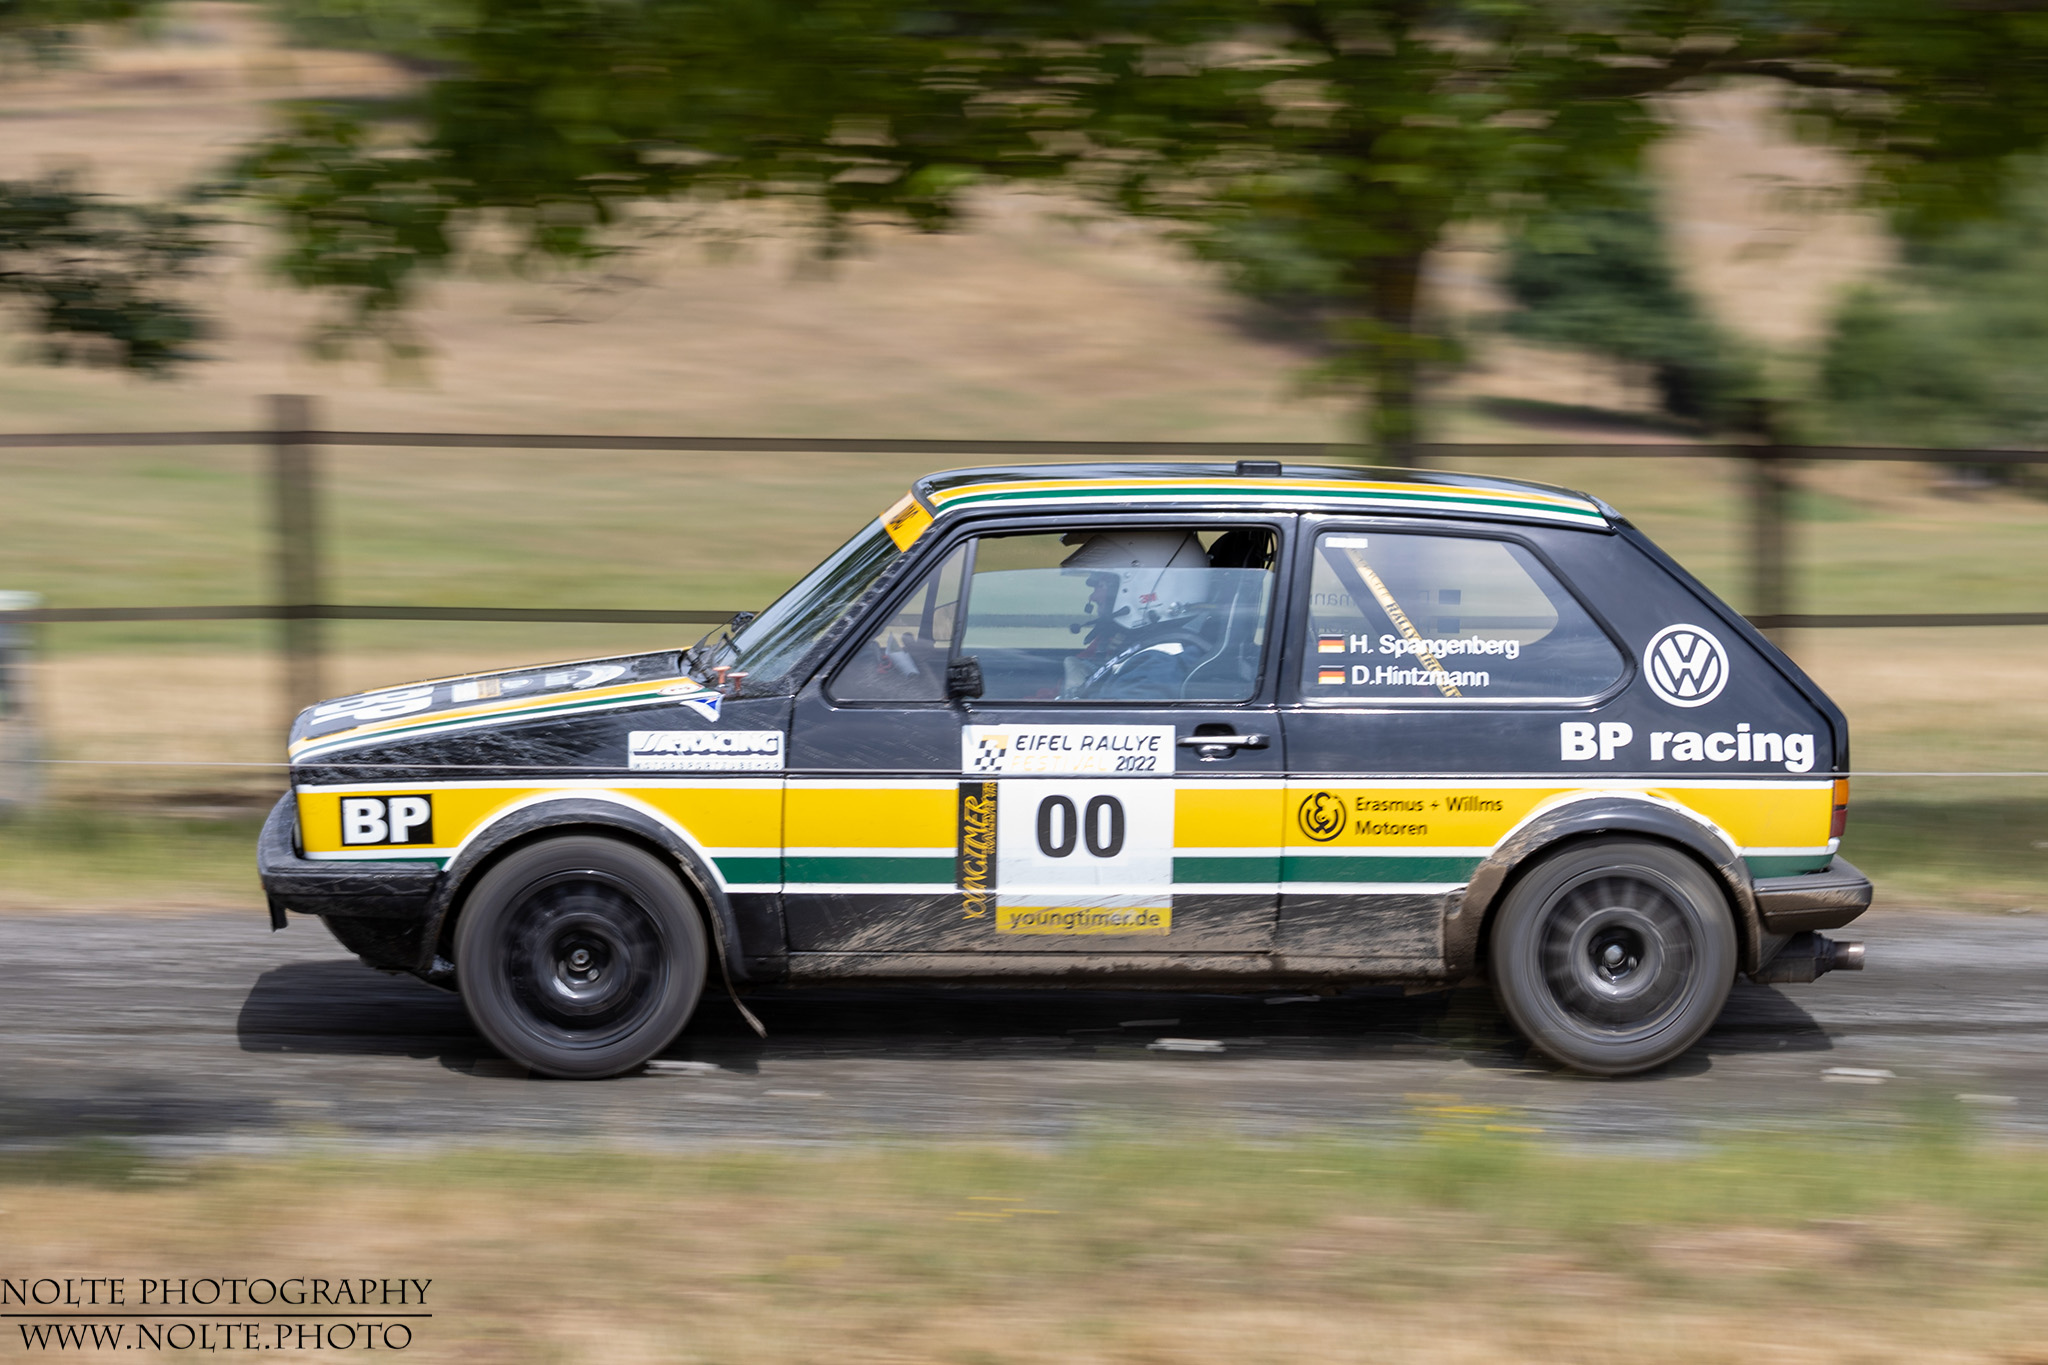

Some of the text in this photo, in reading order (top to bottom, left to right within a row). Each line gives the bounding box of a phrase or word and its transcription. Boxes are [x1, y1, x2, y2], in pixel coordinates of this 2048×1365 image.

[1350, 634, 1520, 660] H. Spangenberg
[1351, 665, 1490, 687] D.Hintzmann
[1015, 735, 1161, 751] EIFEL RALLYE
[1560, 722, 1815, 773] BP racing
[1011, 755, 1157, 772] FESTIVAL 2022
[1355, 796, 1504, 812] Erasmus + Willms
[342, 796, 431, 845] BP
[1036, 794, 1126, 858] 00
[1354, 820, 1428, 836] Motoren
[1009, 908, 1161, 930] youngtimer.de
